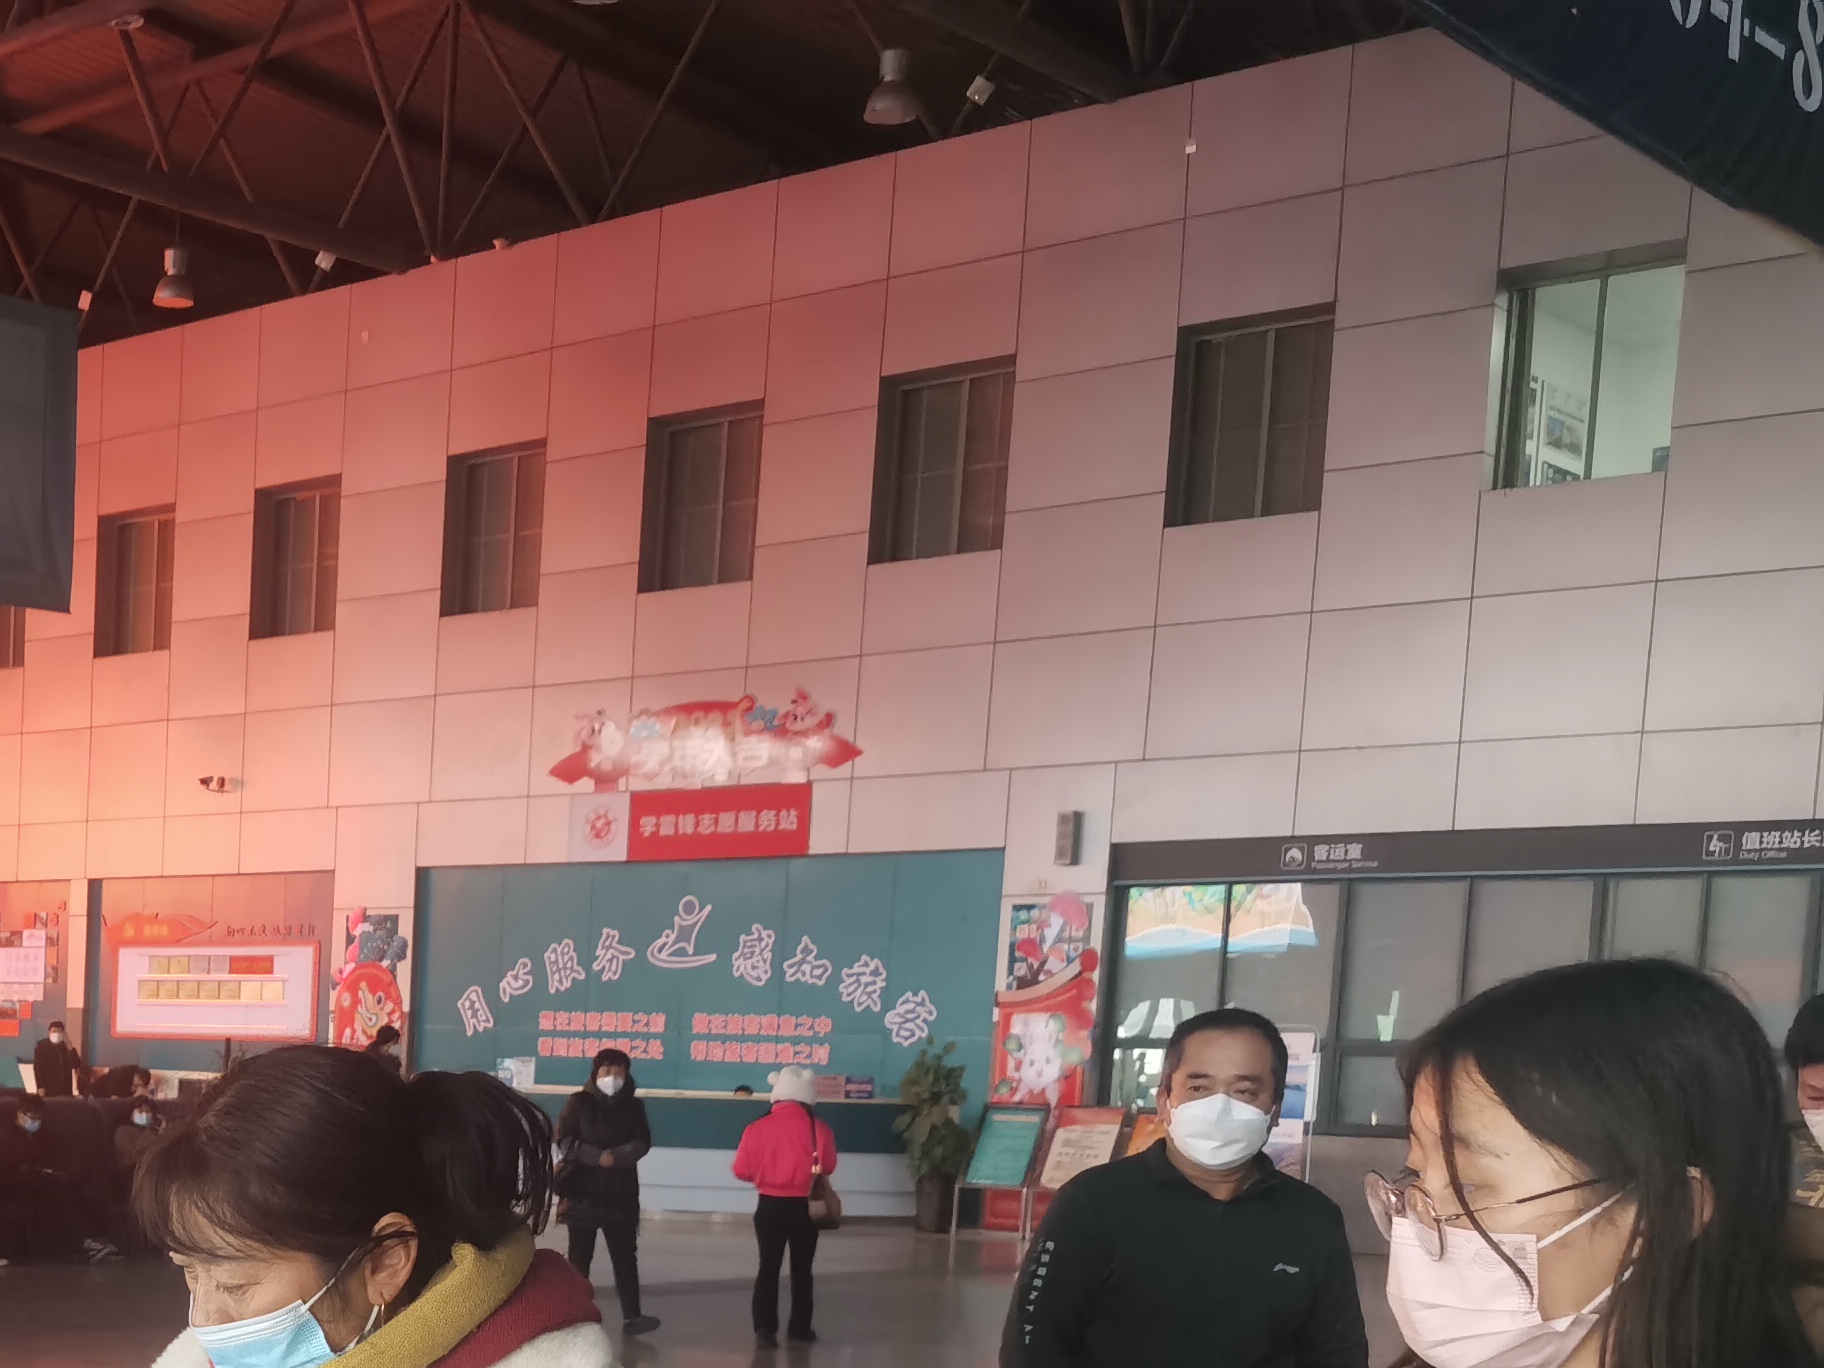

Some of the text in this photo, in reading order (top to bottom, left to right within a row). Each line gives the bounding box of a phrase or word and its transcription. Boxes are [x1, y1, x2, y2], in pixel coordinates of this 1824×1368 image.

[638, 808, 800, 838] 学雷锋志愿服务站
[1741, 828, 1824, 850] 值班站长
[456, 928, 637, 1037] 用心服务
